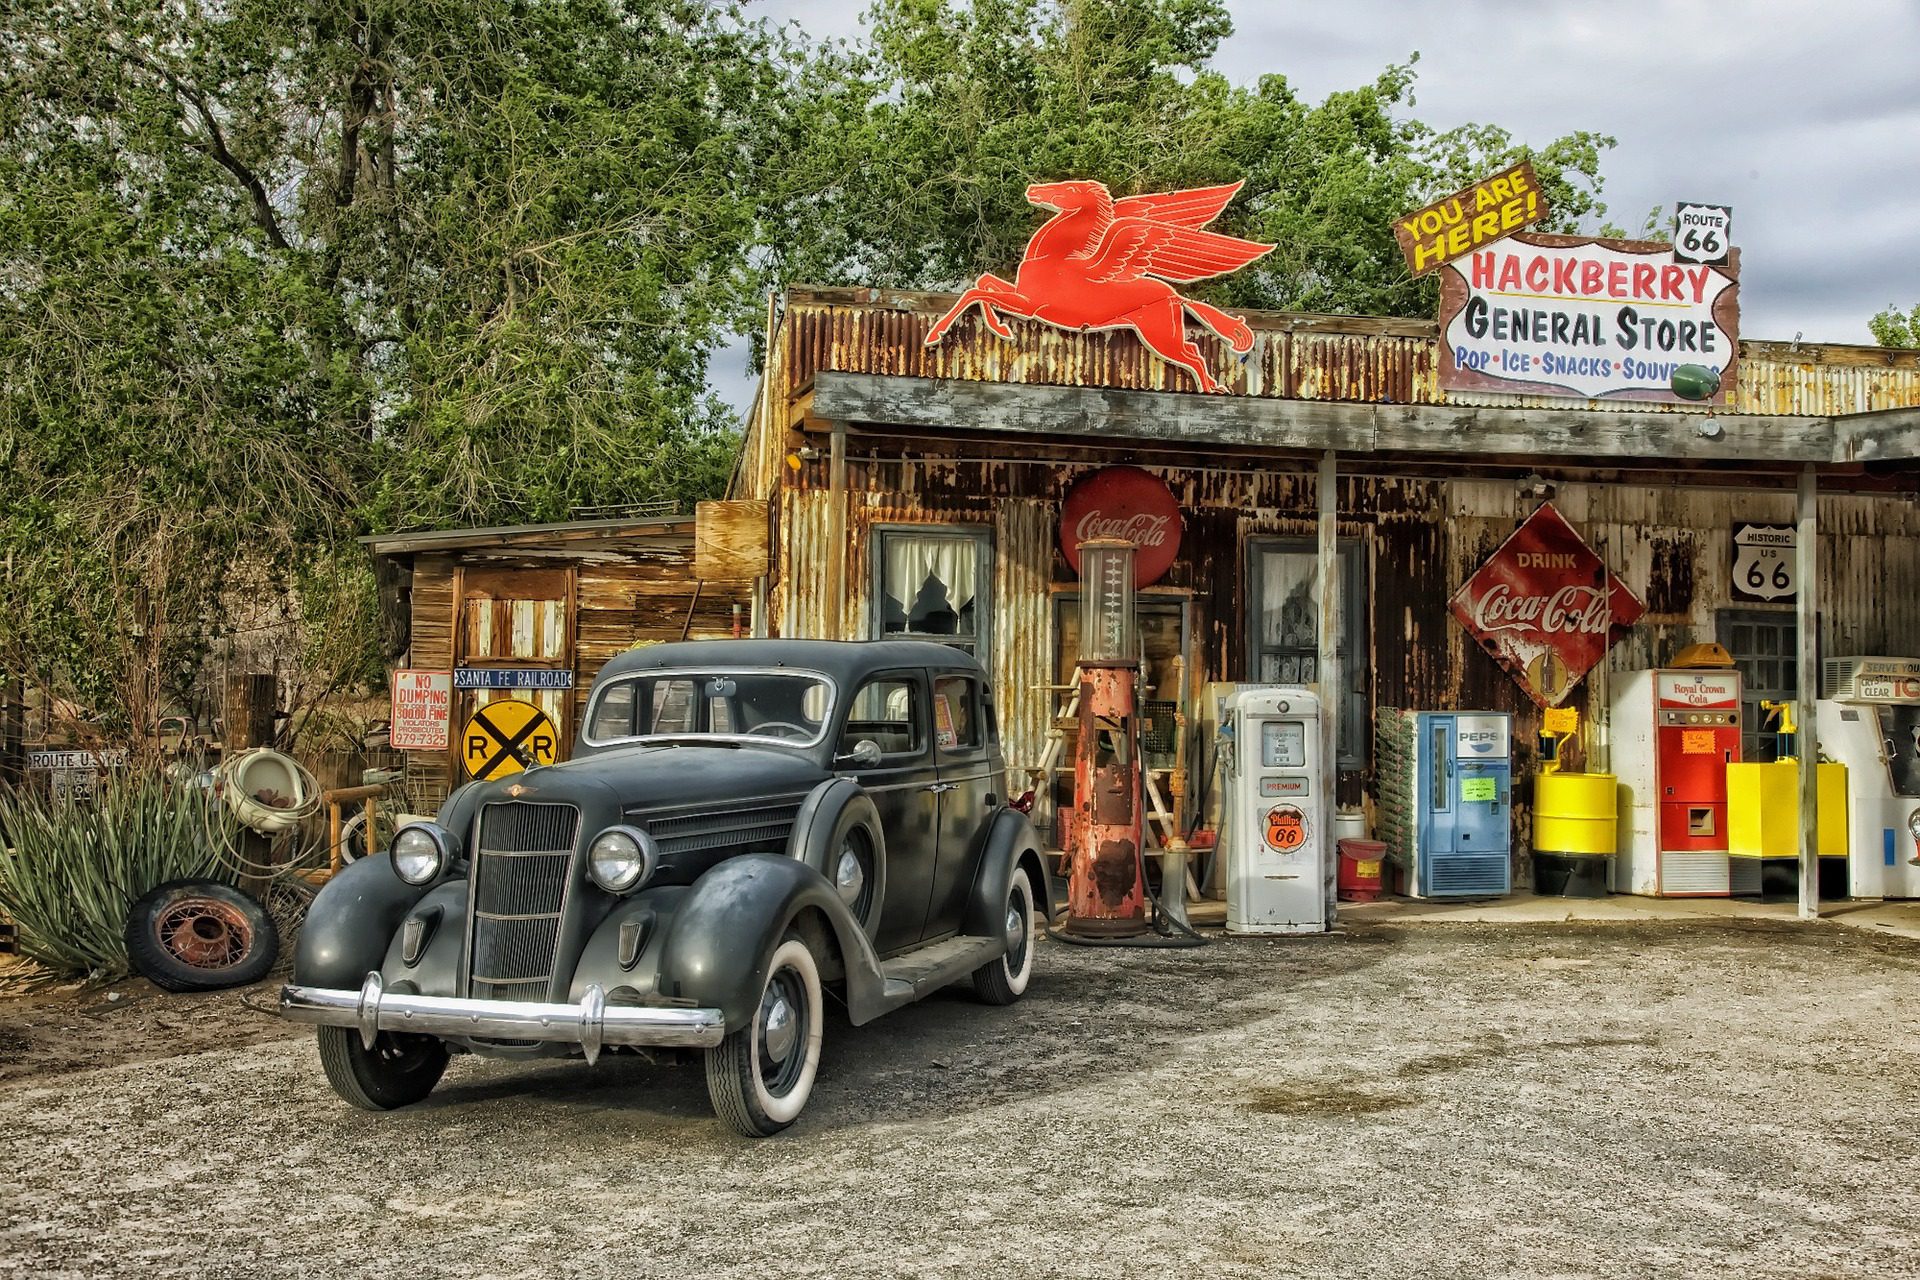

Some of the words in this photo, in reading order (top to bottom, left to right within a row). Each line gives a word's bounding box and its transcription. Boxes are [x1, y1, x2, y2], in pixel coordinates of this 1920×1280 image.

[1404, 200, 1463, 241] YOU
[1476, 170, 1528, 211] ARE
[1683, 213, 1723, 228] ROUTE
[1415, 191, 1537, 271] HERE!
[1683, 229, 1719, 253] 66
[1472, 251, 1711, 304] HACKBERRY
[1465, 296, 1606, 346] GENERAL
[1616, 306, 1715, 353] STORE
[1456, 345, 1490, 369] POP
[1502, 348, 1530, 372] ICE
[1542, 351, 1611, 377] SNACKS
[1076, 510, 1171, 546] Coca-Cola
[1747, 533, 1791, 544] HISTORIC
[1517, 553, 1577, 568] DRINK
[1747, 560, 1790, 589] 66
[1475, 584, 1618, 633] Coca-Cola
[1867, 663, 1897, 673] SERVE
[415, 675, 432, 689] NO
[459, 670, 491, 686] SANTA
[498, 671, 511, 686] FE
[517, 672, 567, 687] RAILROAD
[1861, 674, 1893, 687] CRYSTAL
[399, 689, 447, 704] DUMPING
[1674, 684, 1697, 696] Royal
[1700, 684, 1725, 694] Crown
[1864, 687, 1890, 697] CLEAR
[1688, 694, 1708, 704] Cola
[429, 709, 447, 720] FINE
[396, 734, 446, 745] 979-7325
[468, 735, 488, 759] R
[533, 735, 552, 759] R
[33, 753, 74, 768] ROUTE
[1266, 783, 1301, 791] PREMIUM
[1270, 814, 1299, 826] Phillips
[1275, 828, 1296, 844] 66
